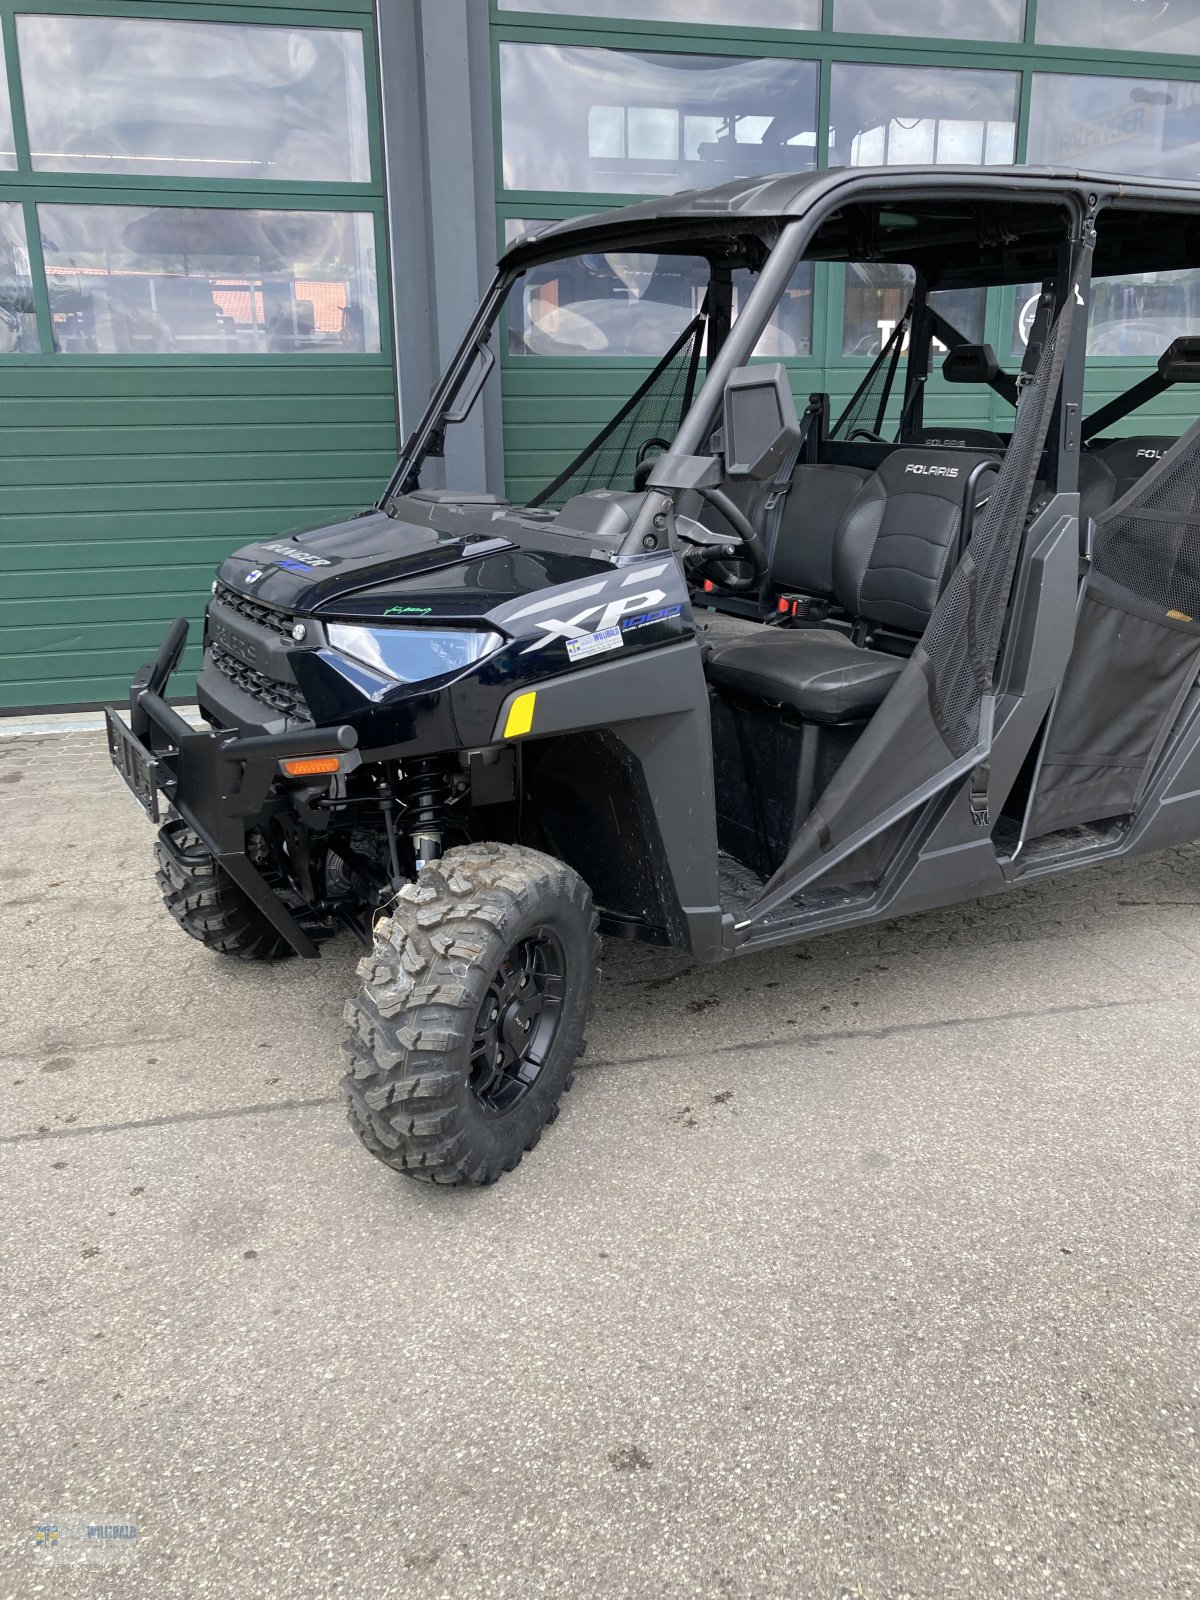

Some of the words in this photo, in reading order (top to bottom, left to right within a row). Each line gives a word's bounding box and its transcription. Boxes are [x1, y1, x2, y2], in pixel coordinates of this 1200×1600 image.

[925, 439, 966, 448] POLARIS
[905, 464, 959, 478] POLARIS
[261, 543, 332, 567] RANGER
[274, 558, 314, 574] XP
[519, 588, 667, 655] XP
[623, 602, 683, 629] 1000
